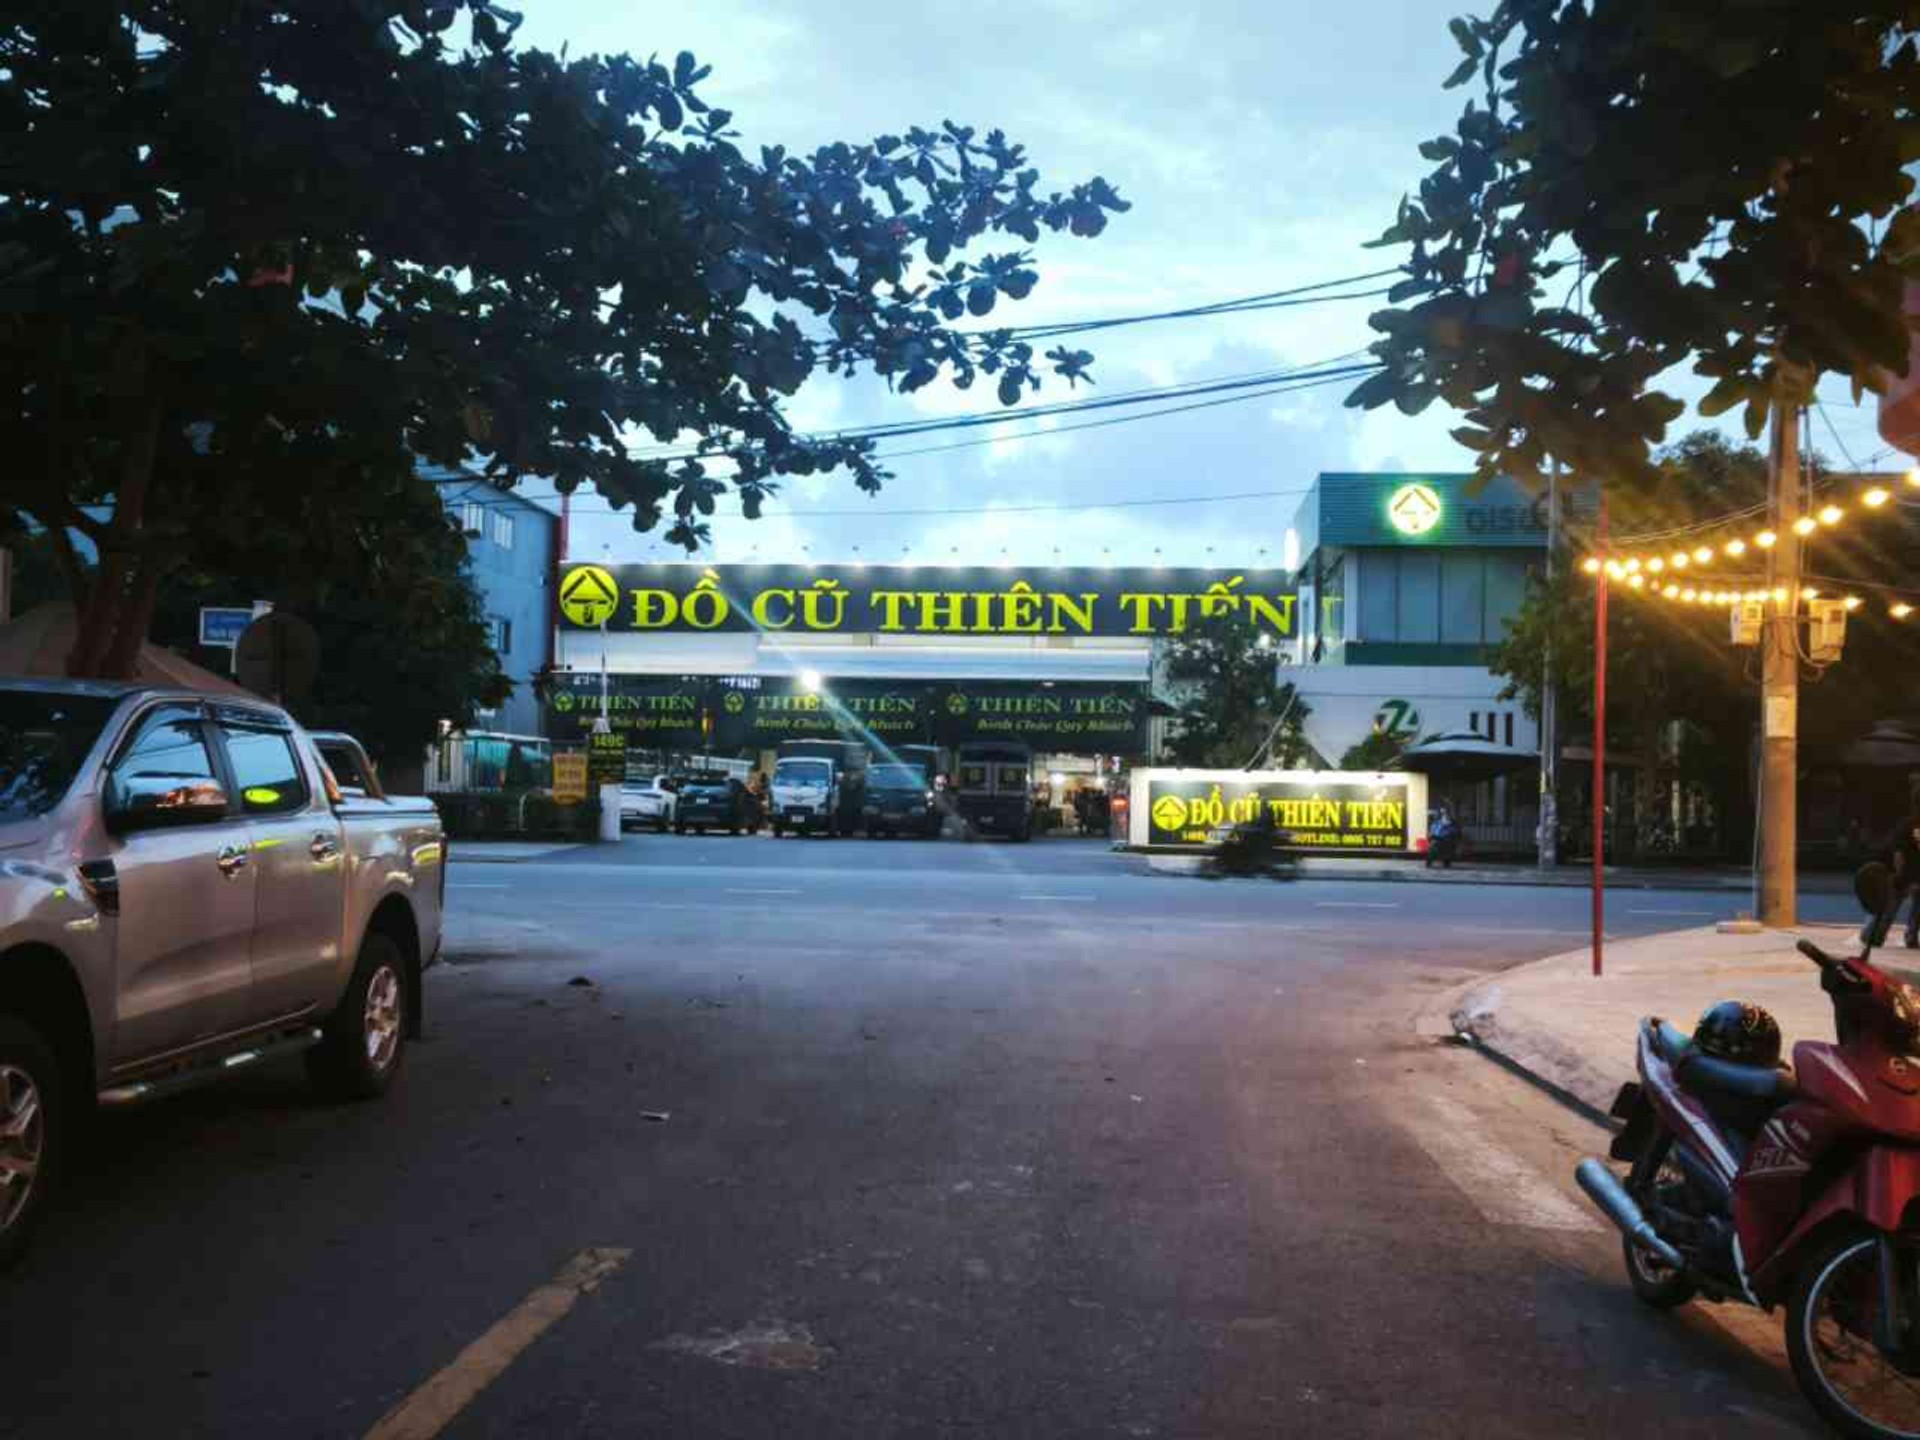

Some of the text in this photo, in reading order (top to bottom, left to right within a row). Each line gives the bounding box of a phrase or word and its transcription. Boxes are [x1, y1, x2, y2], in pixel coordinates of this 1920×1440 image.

[630, 569, 730, 629] ĐỒ
[752, 579, 850, 630] CŨ
[871, 580, 1099, 632] THIÊN
[1191, 784, 1223, 826] ĐỒ
[1269, 794, 1343, 828] THIÊN
[1346, 789, 1404, 829] TIẾN
